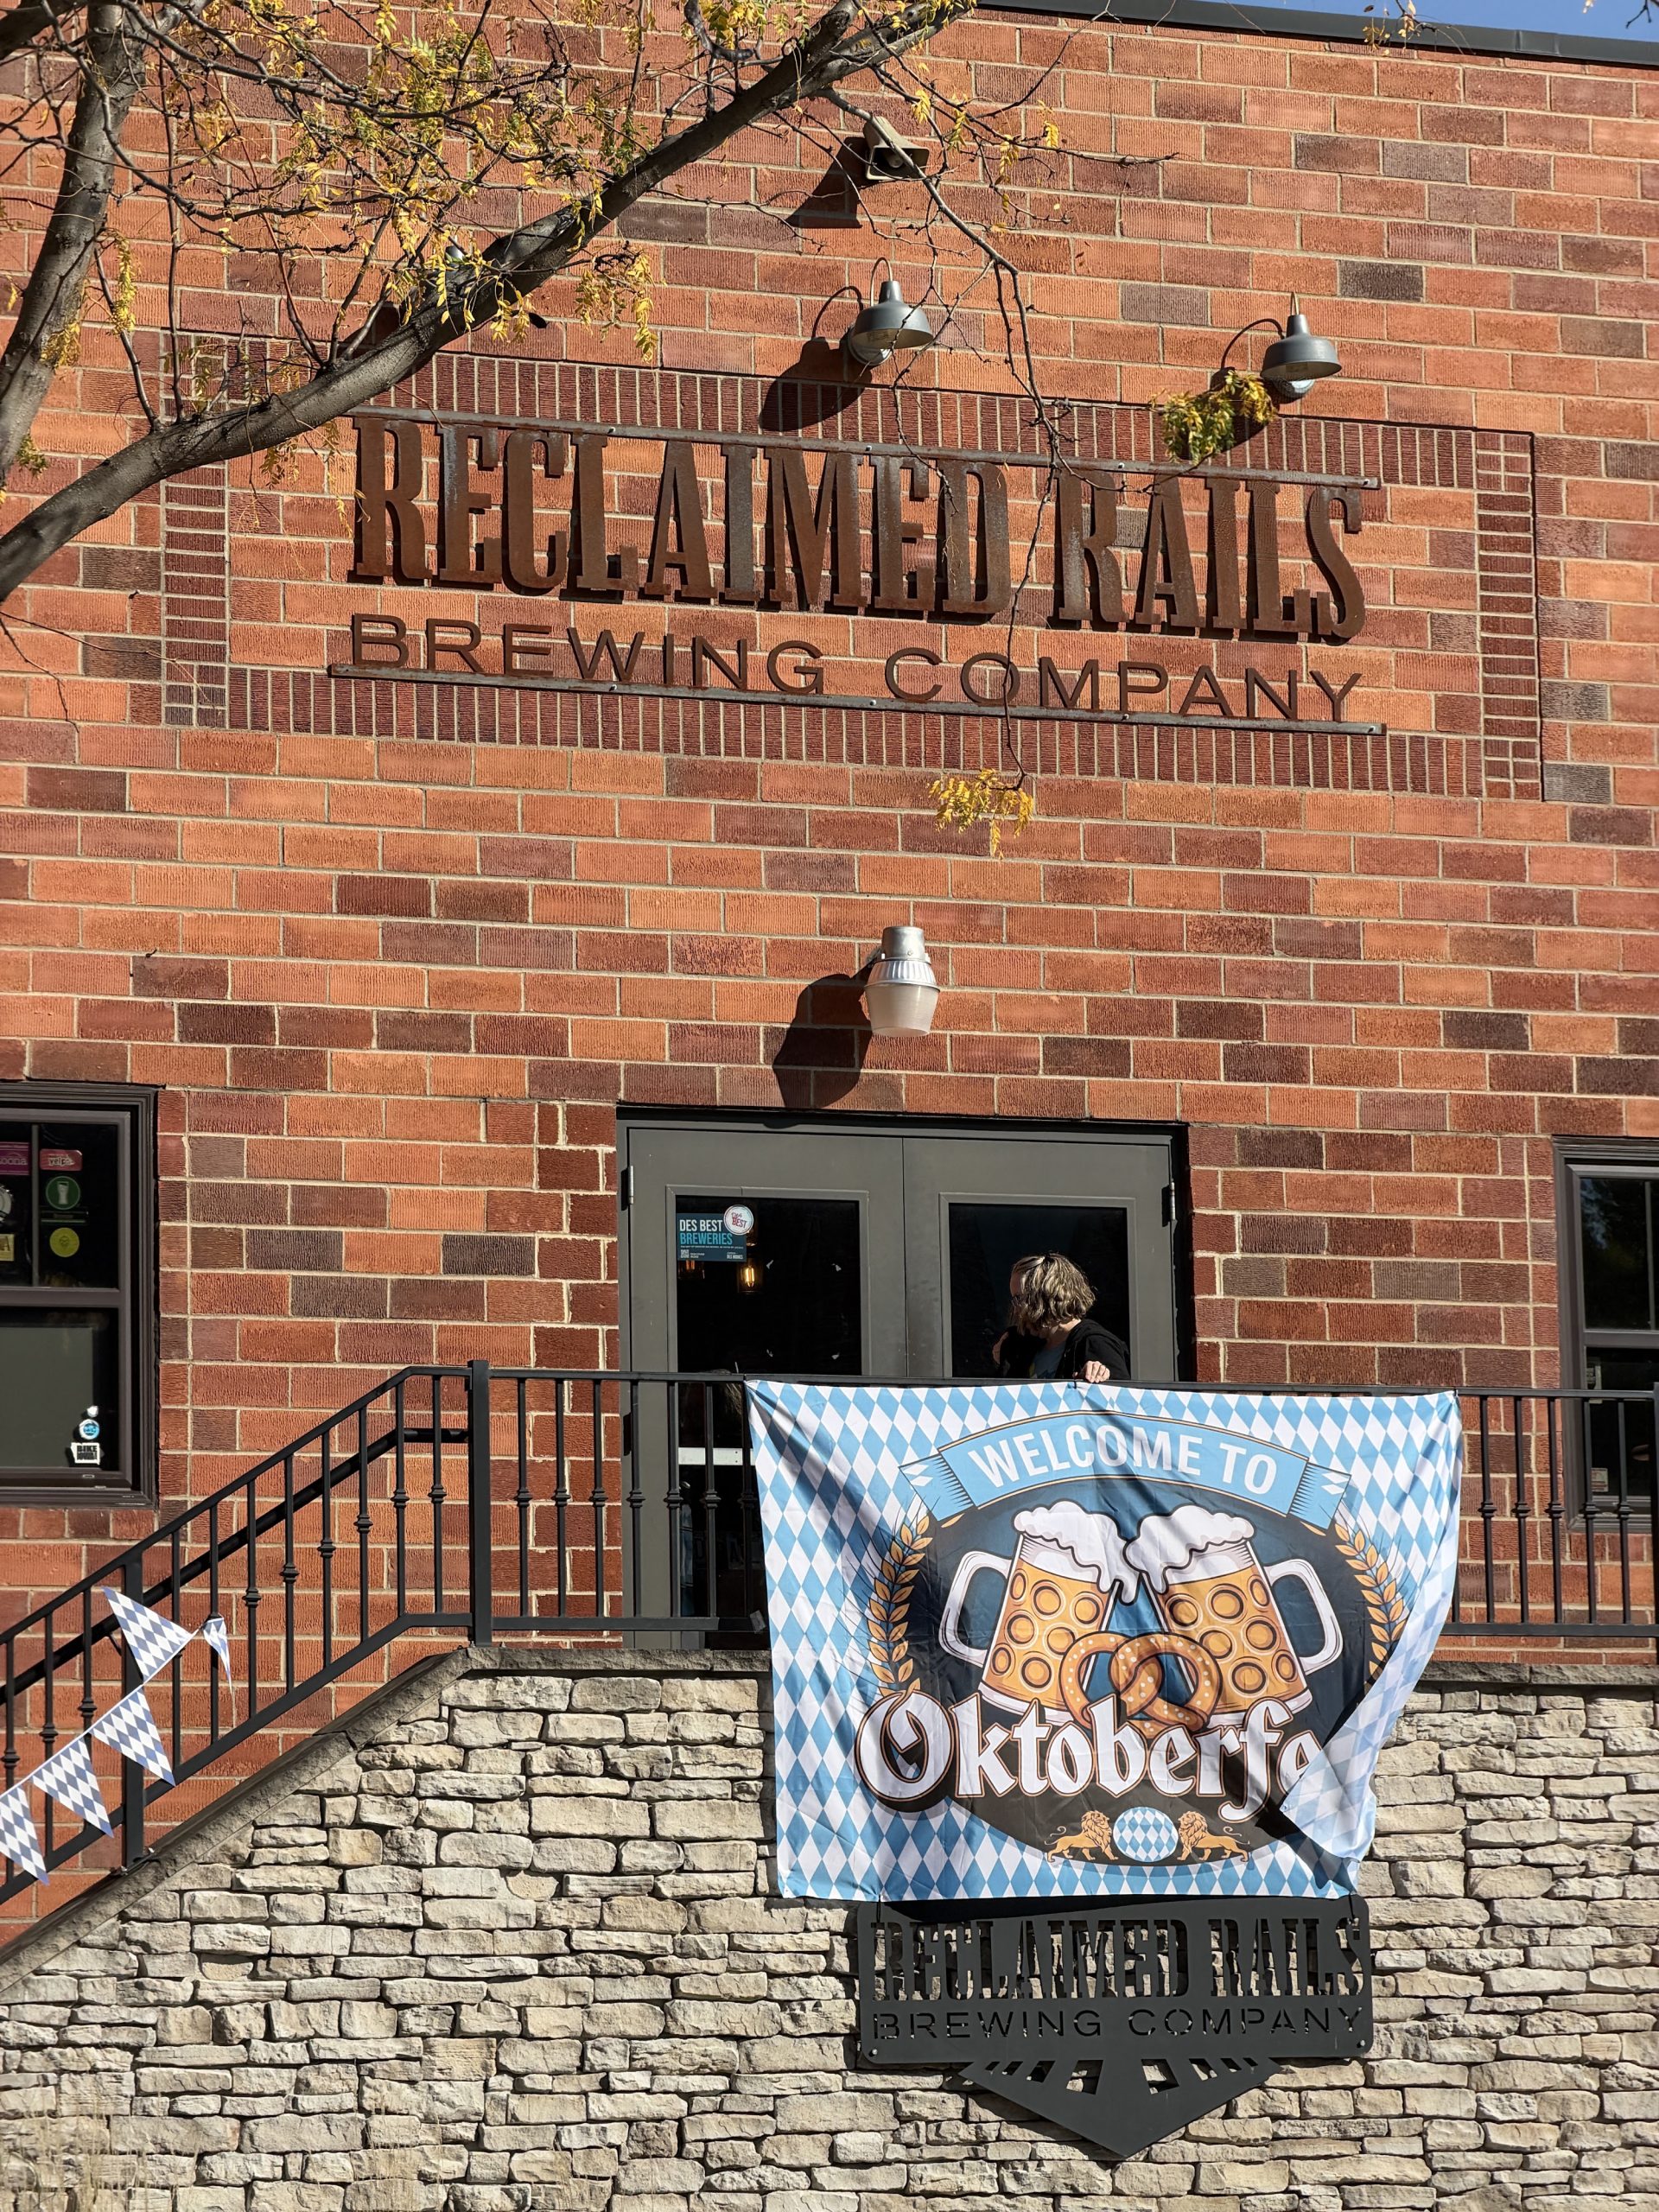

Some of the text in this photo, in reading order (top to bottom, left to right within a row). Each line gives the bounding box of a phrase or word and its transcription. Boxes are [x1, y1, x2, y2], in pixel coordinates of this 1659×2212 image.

[353, 416, 1365, 638] RECLAIMED RAILS
[353, 613, 1363, 723] BREWING COMPANY
[679, 1219, 723, 1232] DES BEST
[680, 1233, 733, 1245] BREWERIES
[968, 1424, 1277, 1495] WELCOME TO
[855, 1693, 1323, 1823] Oktoberfe
[870, 1916, 1365, 2001] RECLAIMED RAILS
[873, 2005, 1363, 2040] BREWING COMPANY
